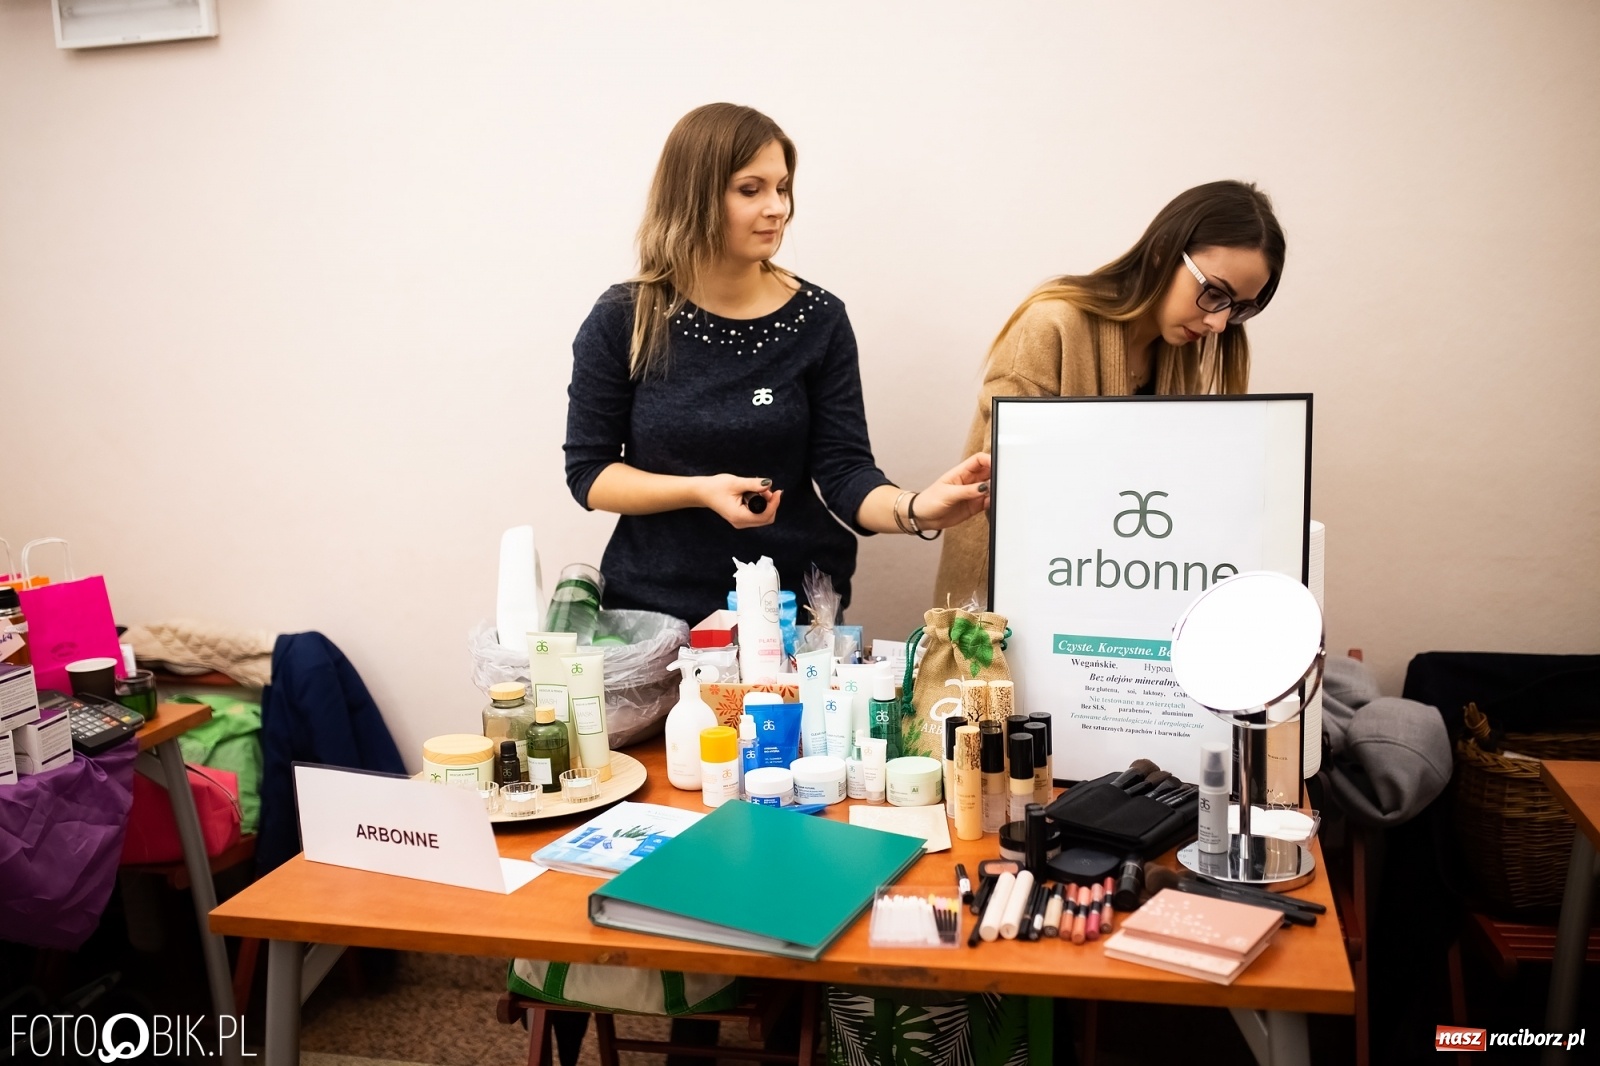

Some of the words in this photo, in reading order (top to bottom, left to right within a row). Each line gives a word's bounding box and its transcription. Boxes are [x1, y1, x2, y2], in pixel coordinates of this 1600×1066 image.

[1048, 549, 1239, 592] arbonne
[1058, 640, 1094, 653] Czyste.
[1098, 642, 1154, 657] Korzystne.
[1157, 646, 1172, 657] Be
[1089, 673, 1104, 682] Bez
[1106, 675, 1133, 685] olejów
[1089, 695, 1100, 703] Nie
[1101, 697, 1135, 706] testowane
[1070, 712, 1101, 721] Testowane
[1161, 710, 1194, 718] aluminium
[1093, 724, 1124, 733] sztucznych
[1124, 727, 1153, 736] zapachów
[1157, 730, 1191, 738] barwników
[356, 823, 440, 849] ARBONNE
